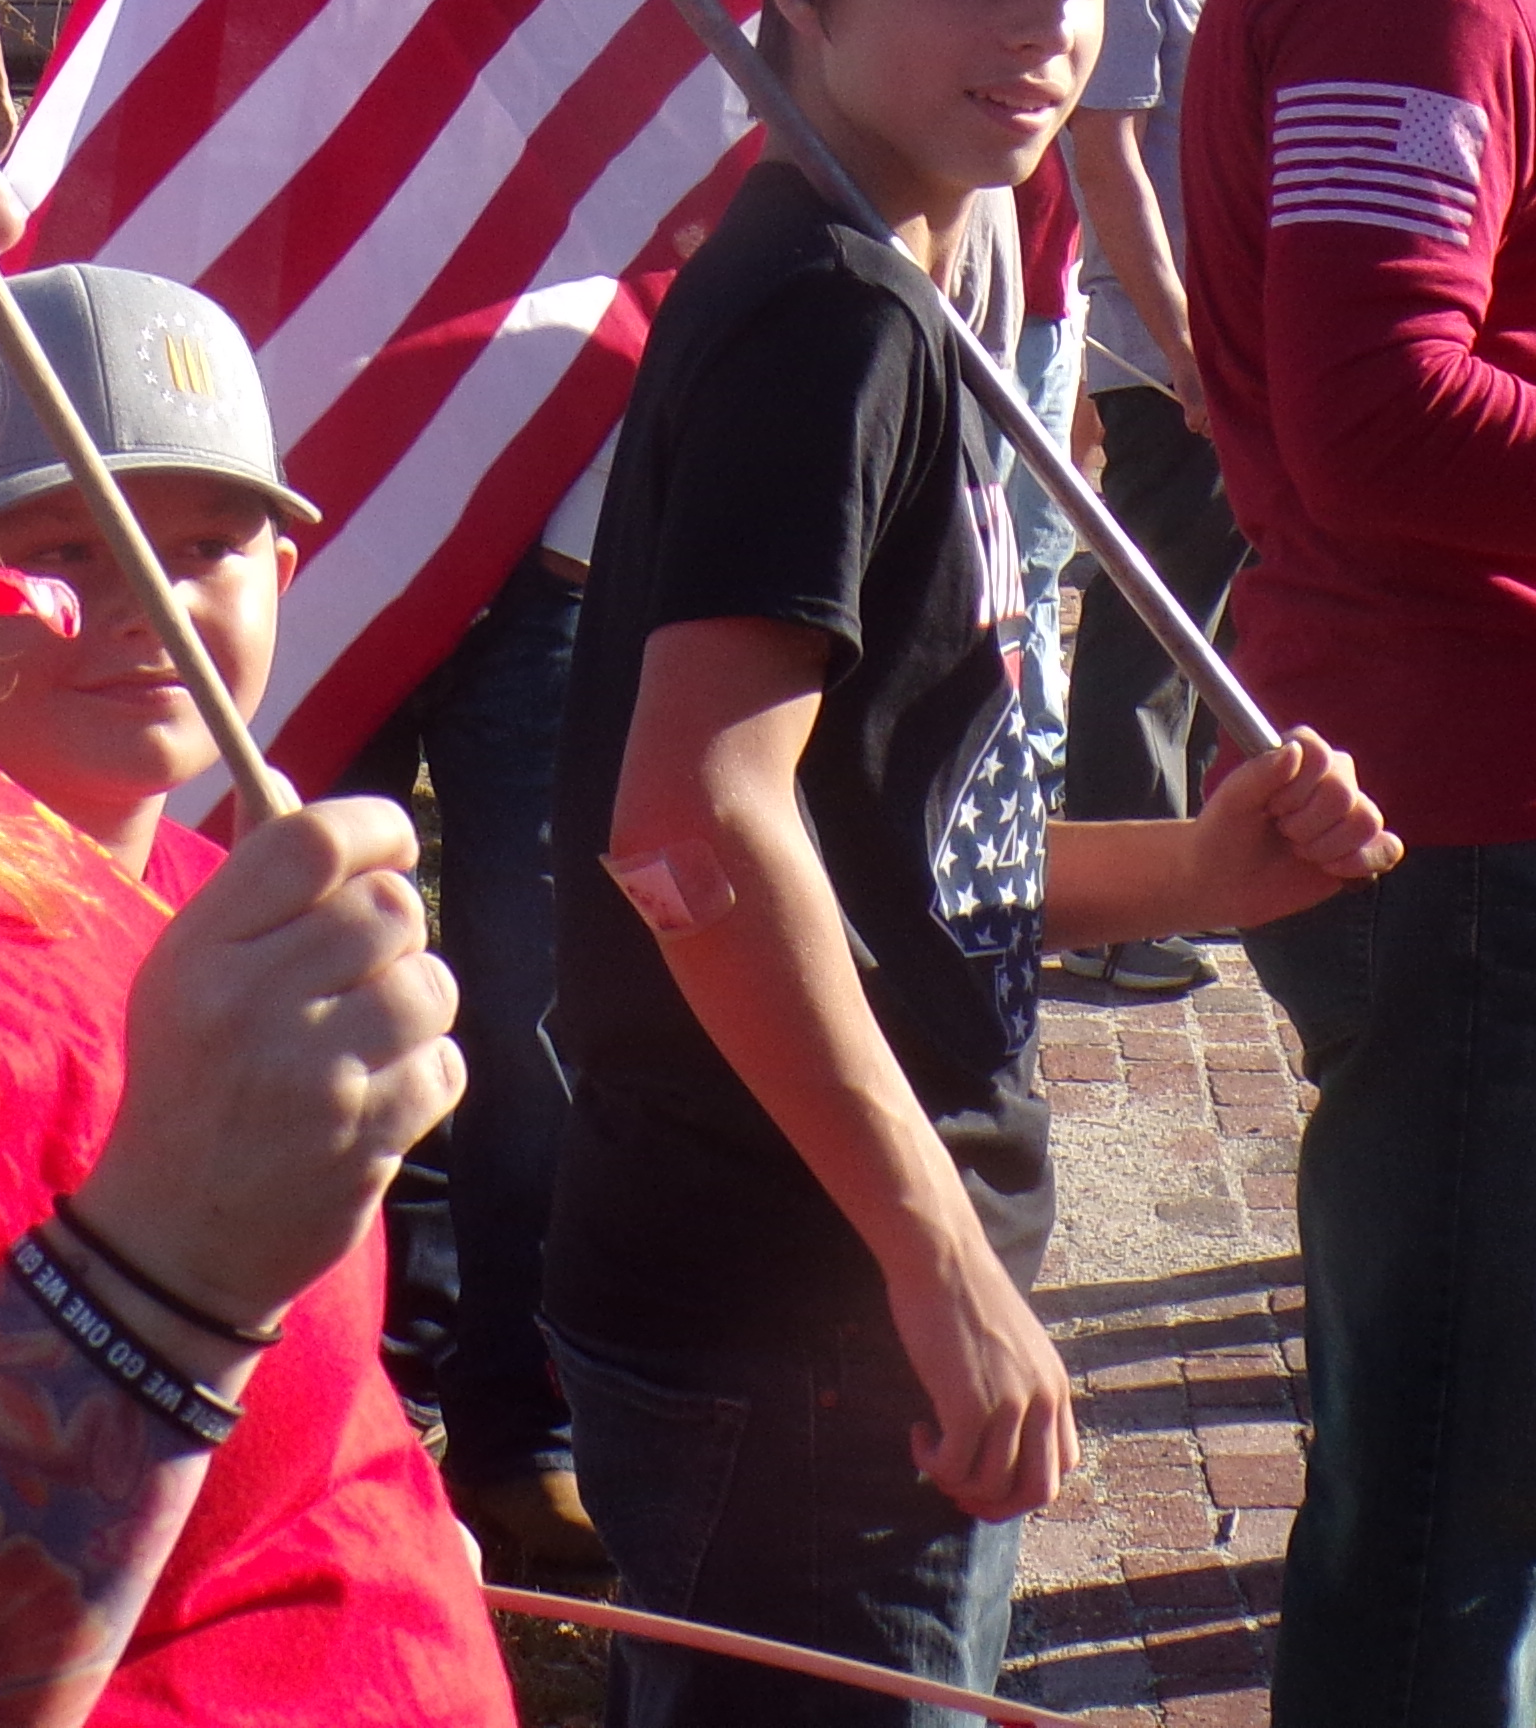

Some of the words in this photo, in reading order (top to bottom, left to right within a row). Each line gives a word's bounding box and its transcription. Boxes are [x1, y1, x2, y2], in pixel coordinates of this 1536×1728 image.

[32, 1266, 68, 1307] WE
[61, 1296, 111, 1349] ONE
[106, 1340, 147, 1380] GO
[140, 1371, 184, 1413] WE
